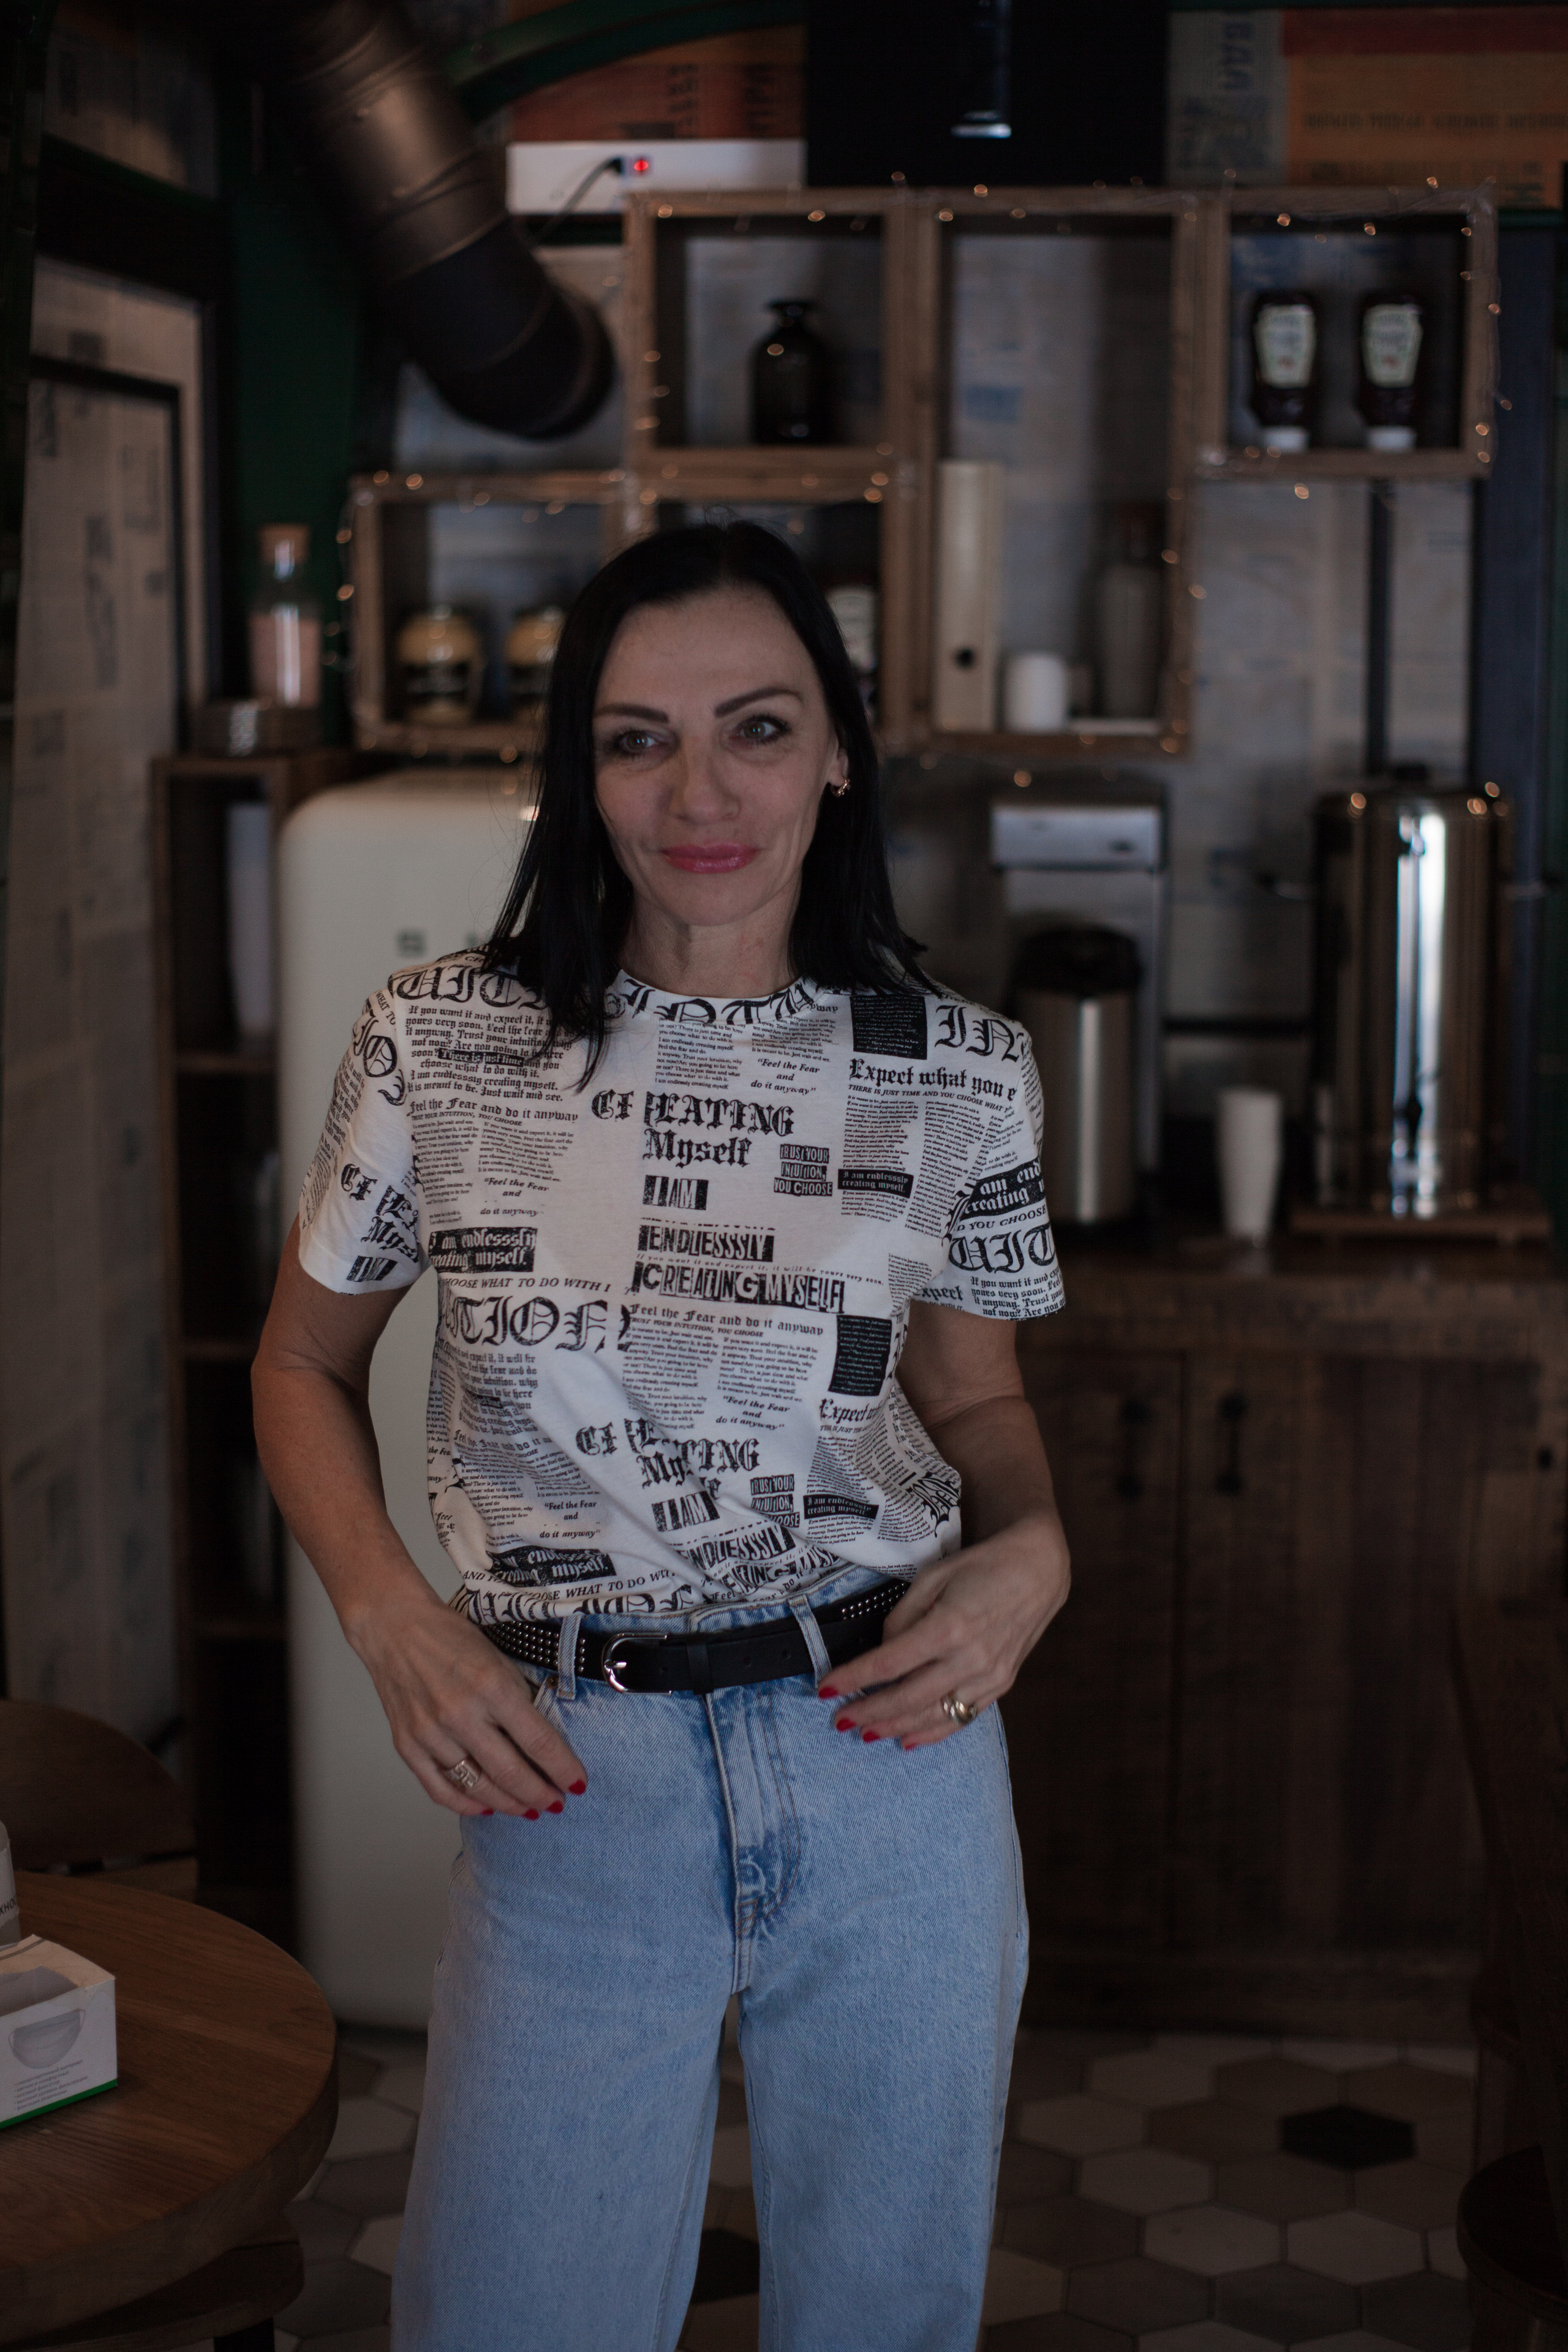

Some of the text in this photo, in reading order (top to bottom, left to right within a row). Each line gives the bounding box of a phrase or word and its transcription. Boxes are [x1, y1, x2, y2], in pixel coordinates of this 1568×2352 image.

[494, 1016, 522, 1024] expect
[415, 1029, 454, 1039] anyway.
[458, 1030, 483, 1039] Trust
[454, 1040, 472, 1050] Are
[493, 1046, 518, 1055] going
[421, 1059, 453, 1069] choose
[456, 1063, 478, 1072] what
[484, 1065, 491, 1073] to
[494, 1065, 504, 1074] do
[508, 1068, 527, 1078] with
[785, 1061, 797, 1071] the
[800, 1063, 820, 1073] Fear
[411, 1070, 415, 1079] I
[484, 1077, 521, 1088] creating
[524, 1082, 558, 1090] myself.
[751, 1080, 763, 1088] do
[777, 1073, 794, 1082] and
[850, 1058, 1003, 1096] Expect what you
[466, 1084, 478, 1093] be.
[481, 1087, 501, 1097] Just
[504, 1089, 524, 1098] wait
[848, 1084, 872, 1093] THERE
[957, 1094, 982, 1106] CHOOSE
[984, 1104, 1003, 1112] WHAT
[429, 1099, 443, 1111] the
[447, 1098, 477, 1109] Fear
[481, 1105, 501, 1114] and
[506, 1107, 518, 1117] do
[523, 1109, 530, 1118] it
[534, 1110, 578, 1123] anyway
[494, 1117, 522, 1126] CHOOSE
[643, 1128, 752, 1169] Myself
[780, 1144, 829, 1163] TRUST YOUR
[781, 1162, 827, 1182] INTUITION,
[528, 1182, 549, 1191] Fear
[669, 1178, 699, 1209] AM
[774, 1178, 833, 1196] YOU CHOOSE
[878, 1182, 905, 1193] myself.
[981, 1178, 1008, 1195] am
[1000, 1204, 1046, 1226] CHOOSE
[442, 1234, 457, 1250] am
[475, 1247, 527, 1268] myself.
[481, 1278, 513, 1287] WHAT
[519, 1278, 535, 1287] TO
[539, 1278, 559, 1287] DO
[564, 1278, 601, 1291] WITH
[846, 1273, 862, 1282] very
[866, 1277, 884, 1286] soon.
[751, 1398, 765, 1409] the
[767, 1403, 790, 1412] Fear
[742, 1409, 761, 1418] and
